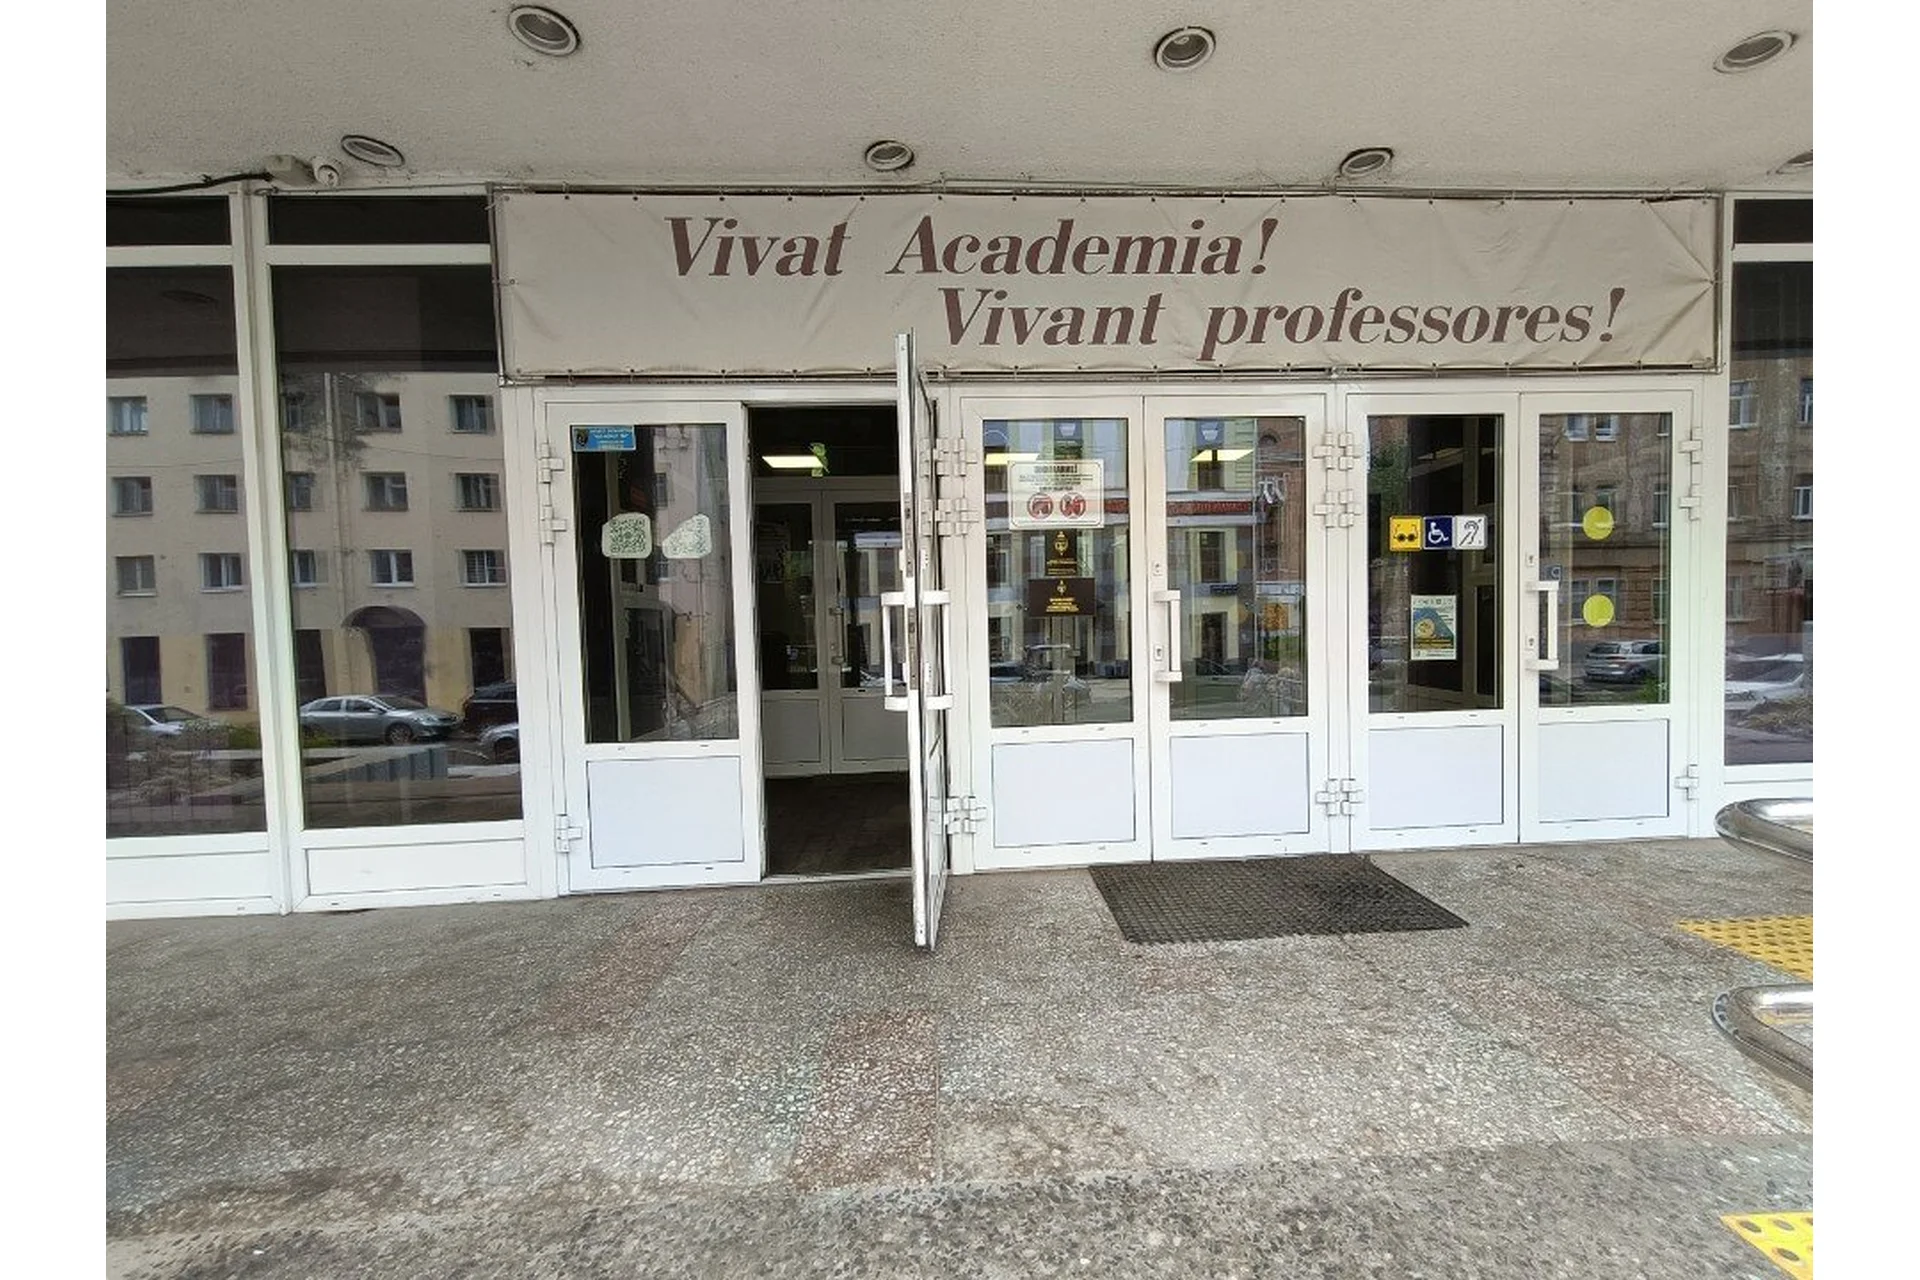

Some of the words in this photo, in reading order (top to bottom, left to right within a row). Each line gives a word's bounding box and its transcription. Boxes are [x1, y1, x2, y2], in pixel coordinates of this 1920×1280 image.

[665, 216, 850, 277] Vivat
[886, 216, 1279, 276] Academia!
[938, 287, 1166, 346] Vivant
[1197, 287, 1626, 362] professores!
